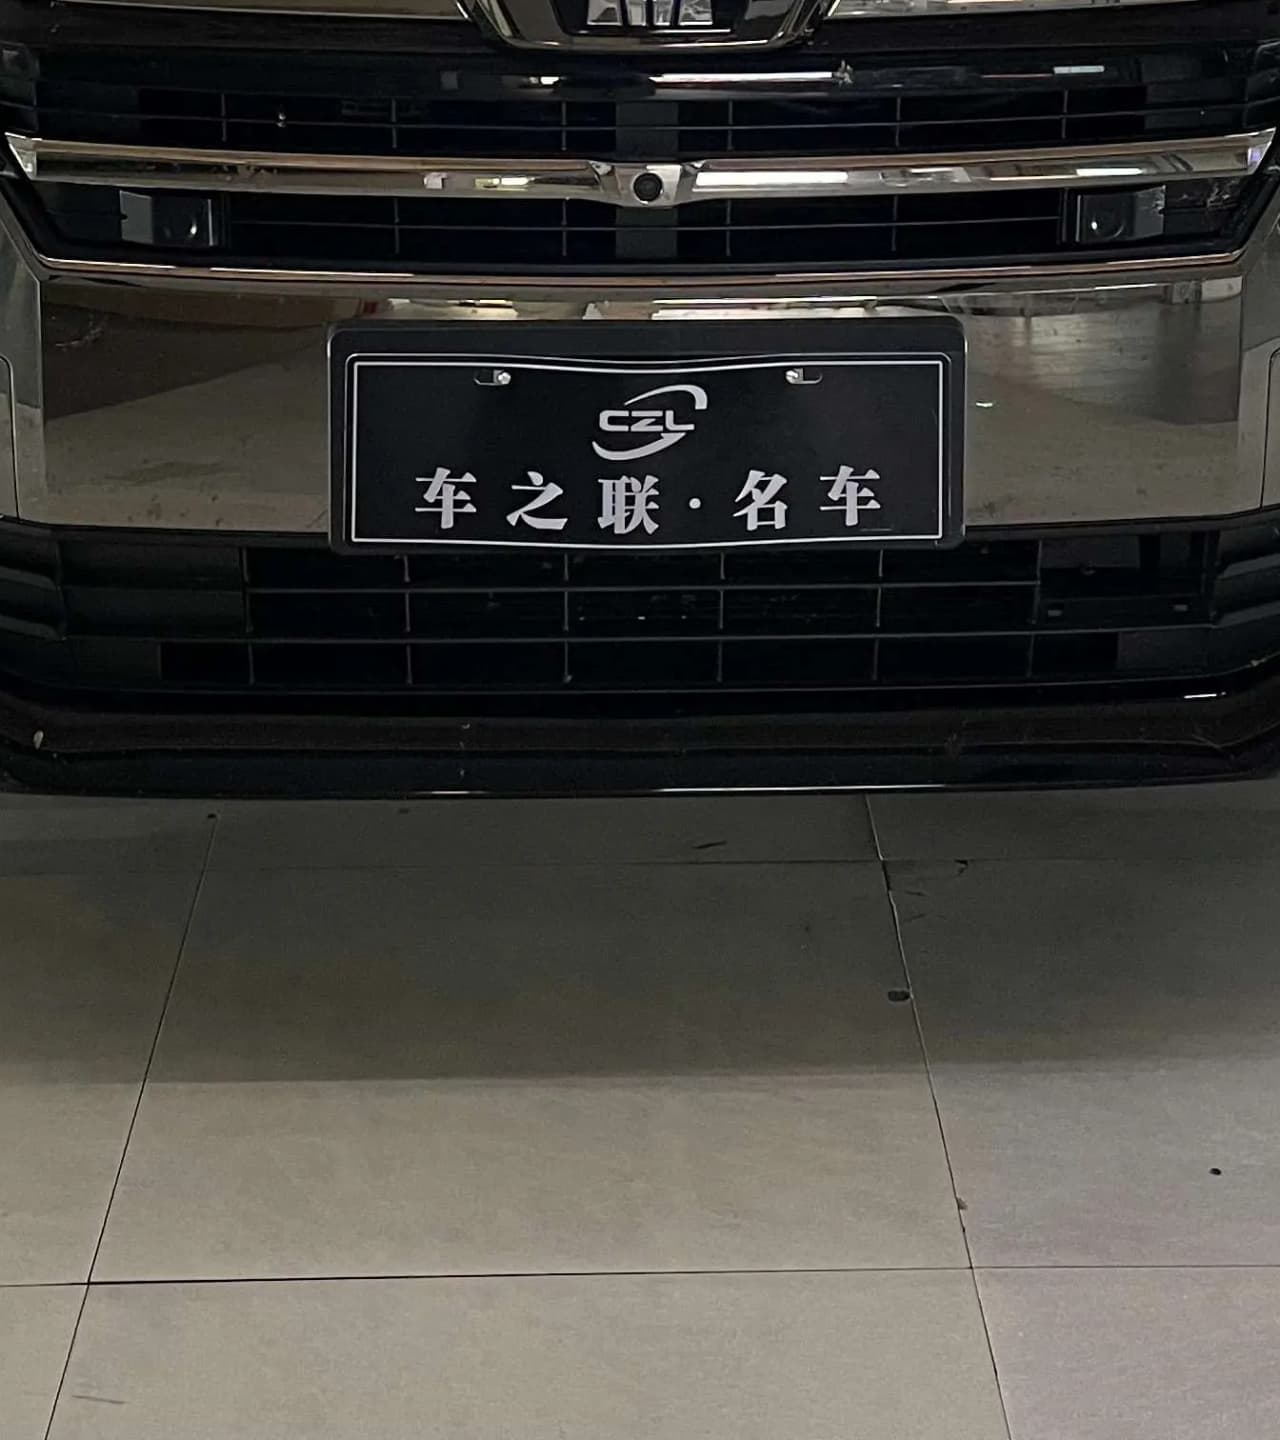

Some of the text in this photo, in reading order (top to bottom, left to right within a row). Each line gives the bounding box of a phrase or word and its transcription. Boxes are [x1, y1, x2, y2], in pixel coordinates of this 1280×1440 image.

[598, 410, 695, 432] CZL
[415, 465, 881, 535] 车之联·名车
